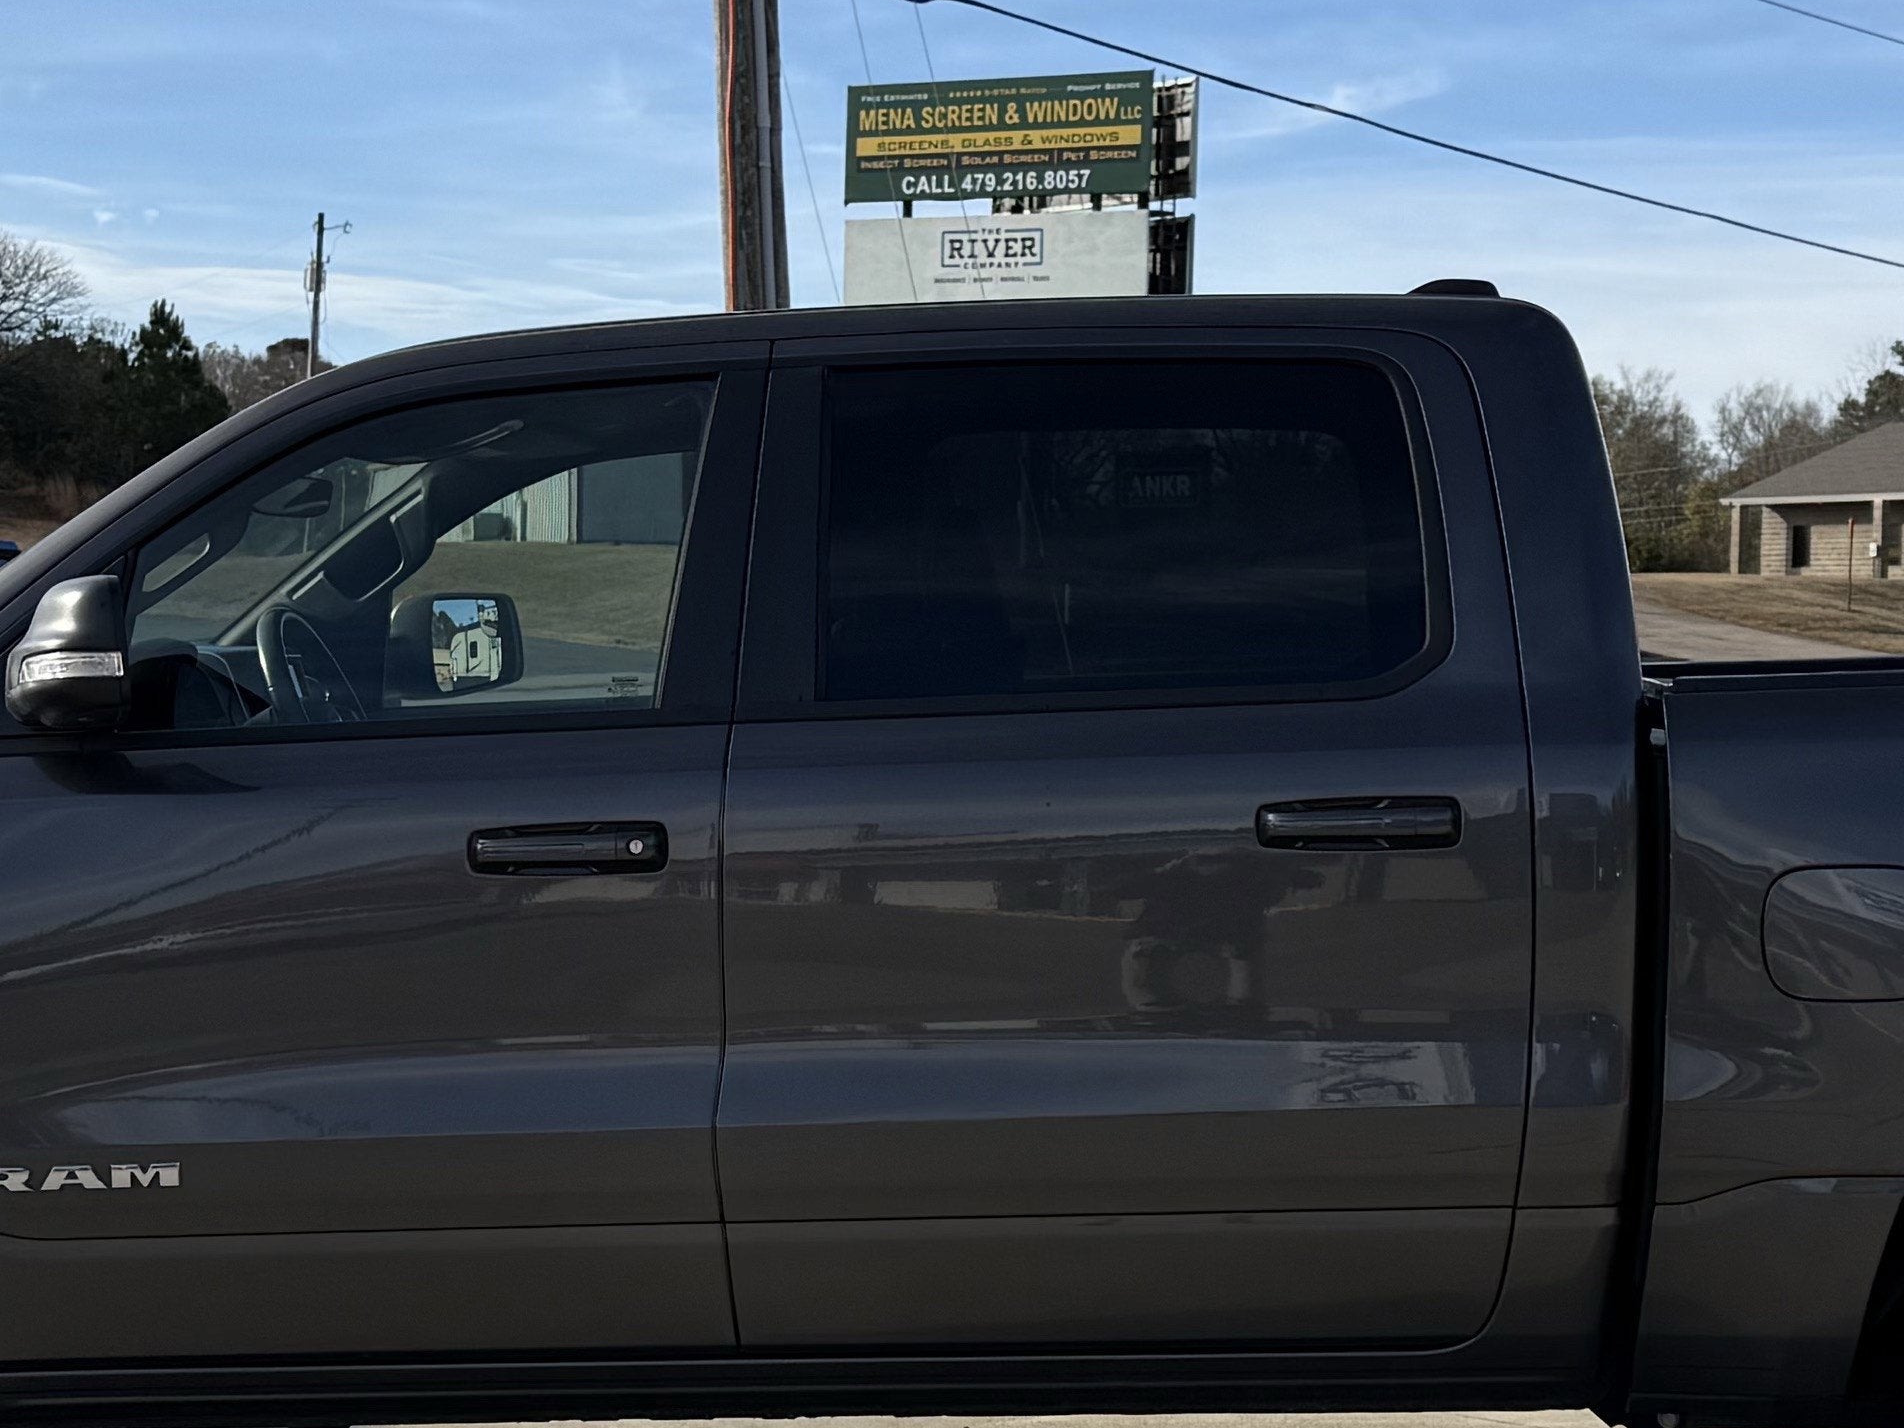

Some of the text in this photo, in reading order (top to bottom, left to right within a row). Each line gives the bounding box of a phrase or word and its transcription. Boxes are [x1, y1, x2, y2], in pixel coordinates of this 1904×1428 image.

[859, 96, 1143, 132] MENA SCREEN & WINDOW LLC
[960, 136, 1014, 149] GLASS
[1020, 133, 1034, 146] &
[1040, 131, 1120, 145] WINDOWS
[901, 169, 1091, 195] CALL 479.216.8057
[981, 228, 1002, 236] THE
[948, 236, 1038, 259] RIVER
[963, 262, 1020, 270] COMPANY
